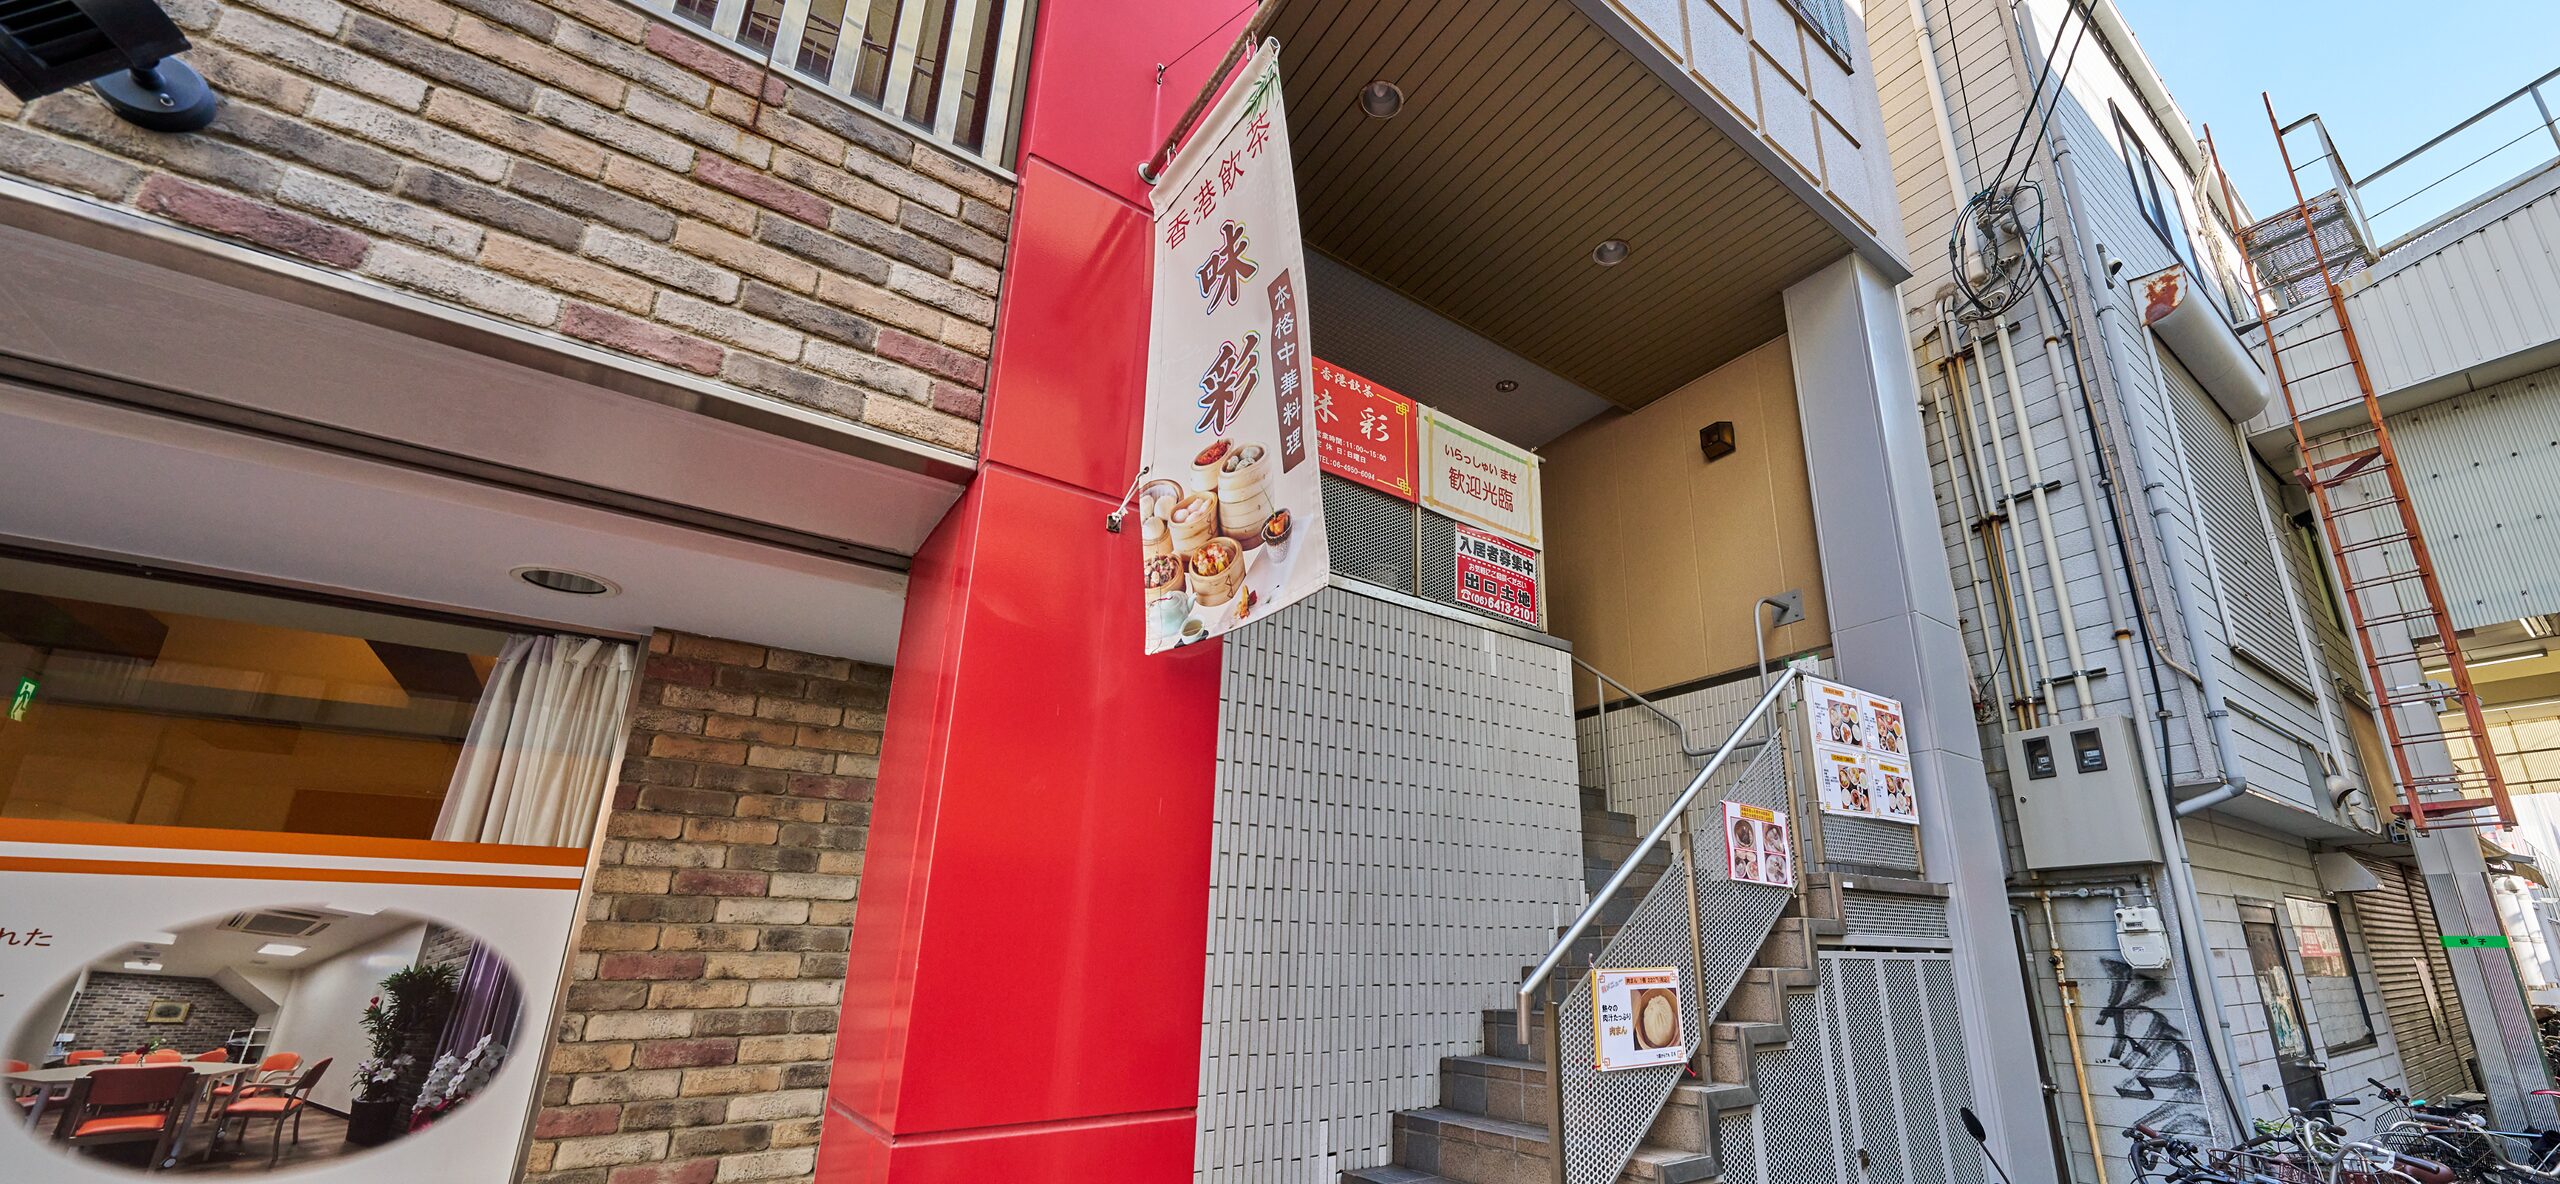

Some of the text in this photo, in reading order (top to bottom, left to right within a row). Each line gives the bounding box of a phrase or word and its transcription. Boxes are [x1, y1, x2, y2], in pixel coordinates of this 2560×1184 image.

[1166, 109, 1270, 250] 香港飲茶
[1196, 220, 1260, 435] 味彩
[1274, 285, 1302, 456] 本格中華料理
[1321, 366, 1374, 398] 香港飲茶
[1448, 466, 1514, 513] 歓迎光臨
[1459, 535, 1534, 576] 入居者募集中
[1464, 571, 1532, 609] 出口土地
[1471, 593, 1535, 622] (06)6413-2101
